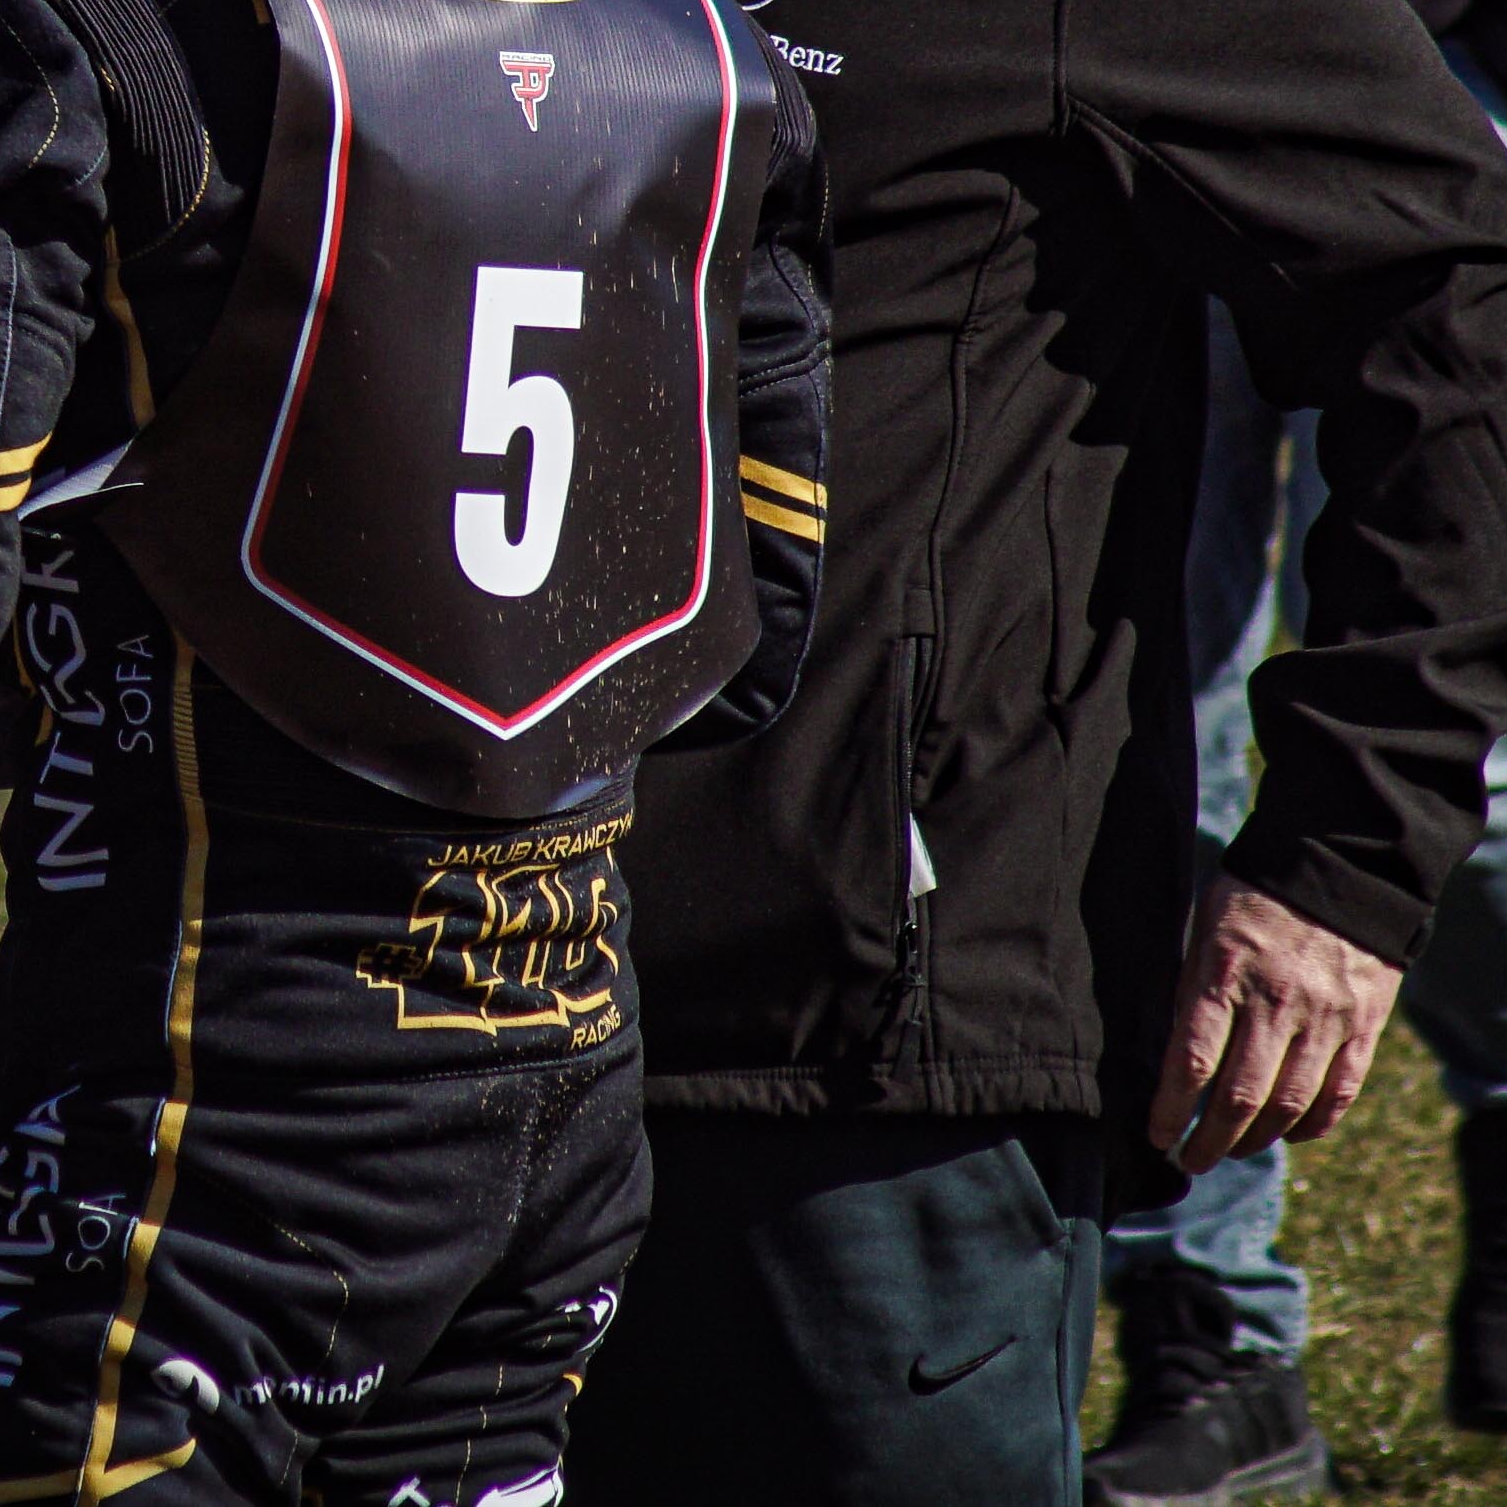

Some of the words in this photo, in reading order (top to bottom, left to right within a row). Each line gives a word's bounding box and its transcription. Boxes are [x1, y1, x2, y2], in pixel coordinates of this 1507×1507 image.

[452, 265, 584, 599] 5
[115, 633, 155, 755] SOFA
[427, 842, 533, 868] JAKUB
[569, 1003, 624, 1051] RACING
